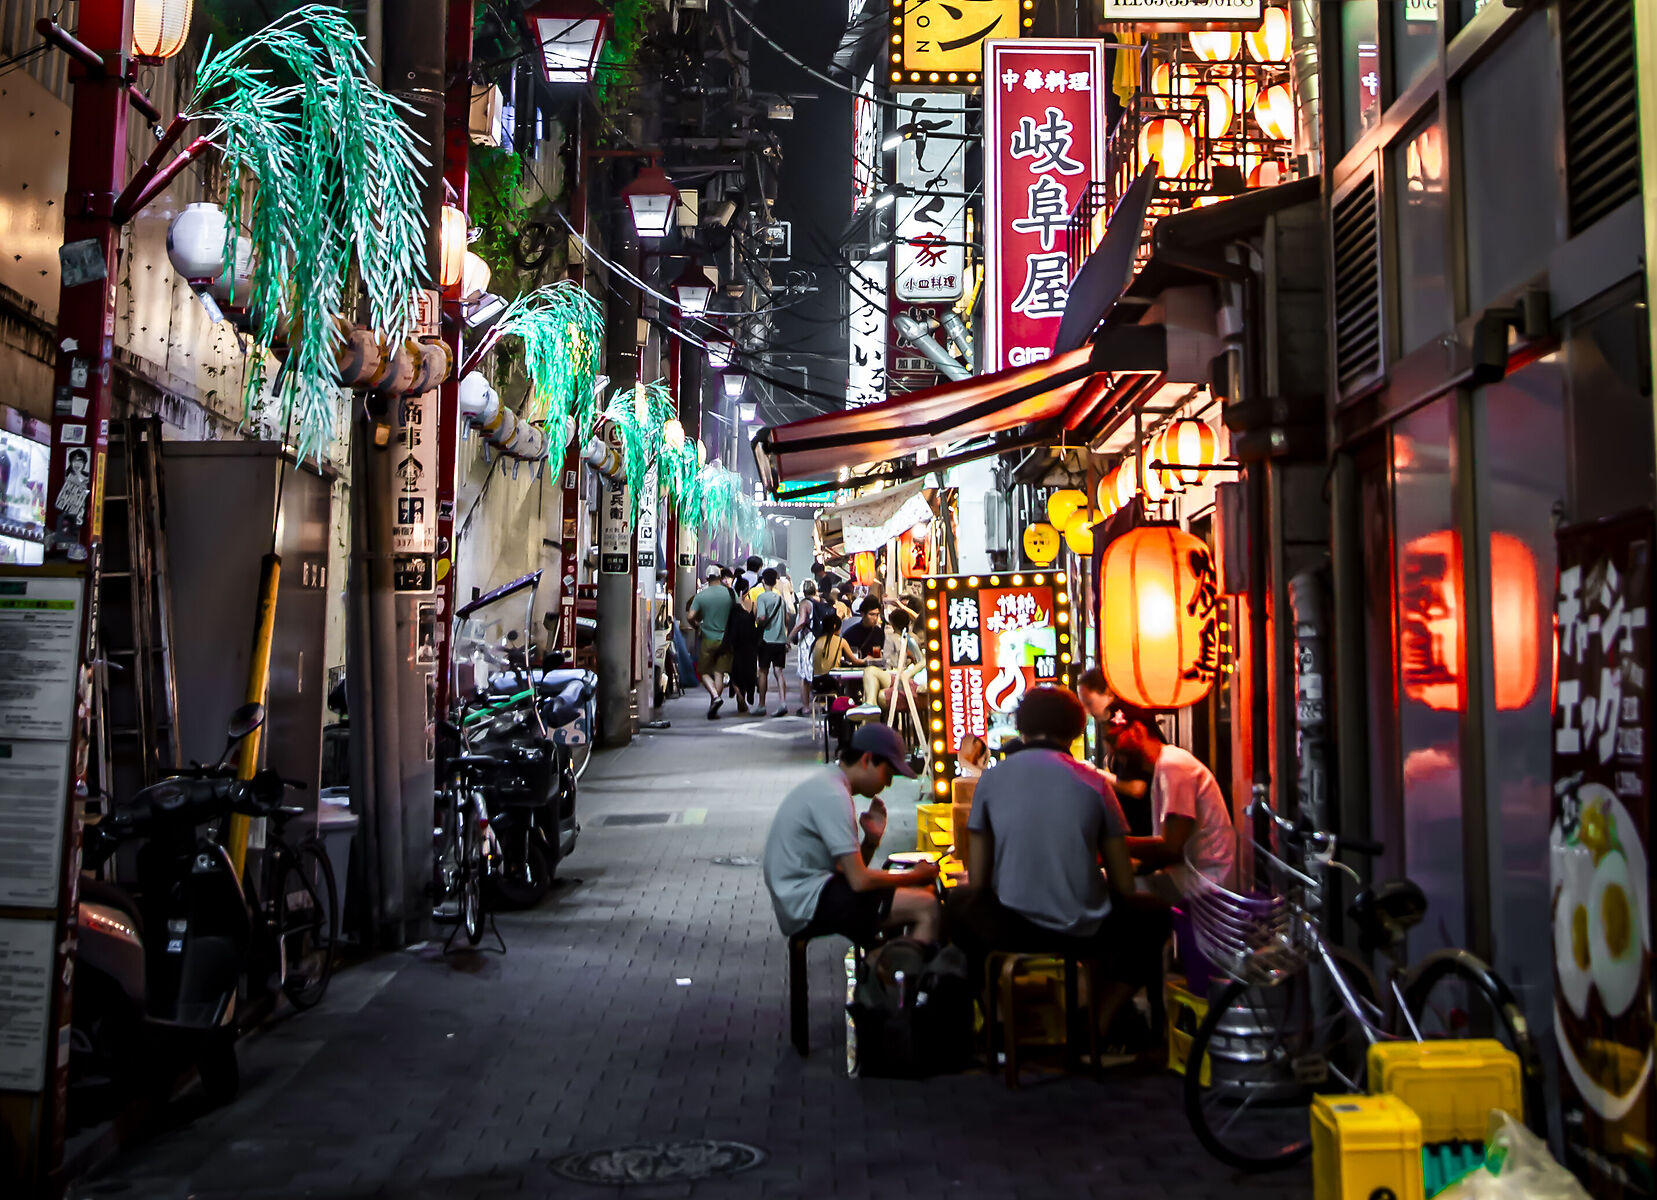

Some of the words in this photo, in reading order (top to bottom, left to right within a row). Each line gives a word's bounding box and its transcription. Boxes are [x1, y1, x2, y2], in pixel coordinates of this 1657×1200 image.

[1001, 67, 1091, 93] 中華料理
[1010, 106, 1085, 320] 岐阜屋
[904, 276, 957, 292] 小皿料理
[1008, 346, 1050, 367] GIF
[400, 575, 423, 586] 1-2
[997, 592, 1037, 616] 情熱
[948, 596, 980, 663] 焼肉
